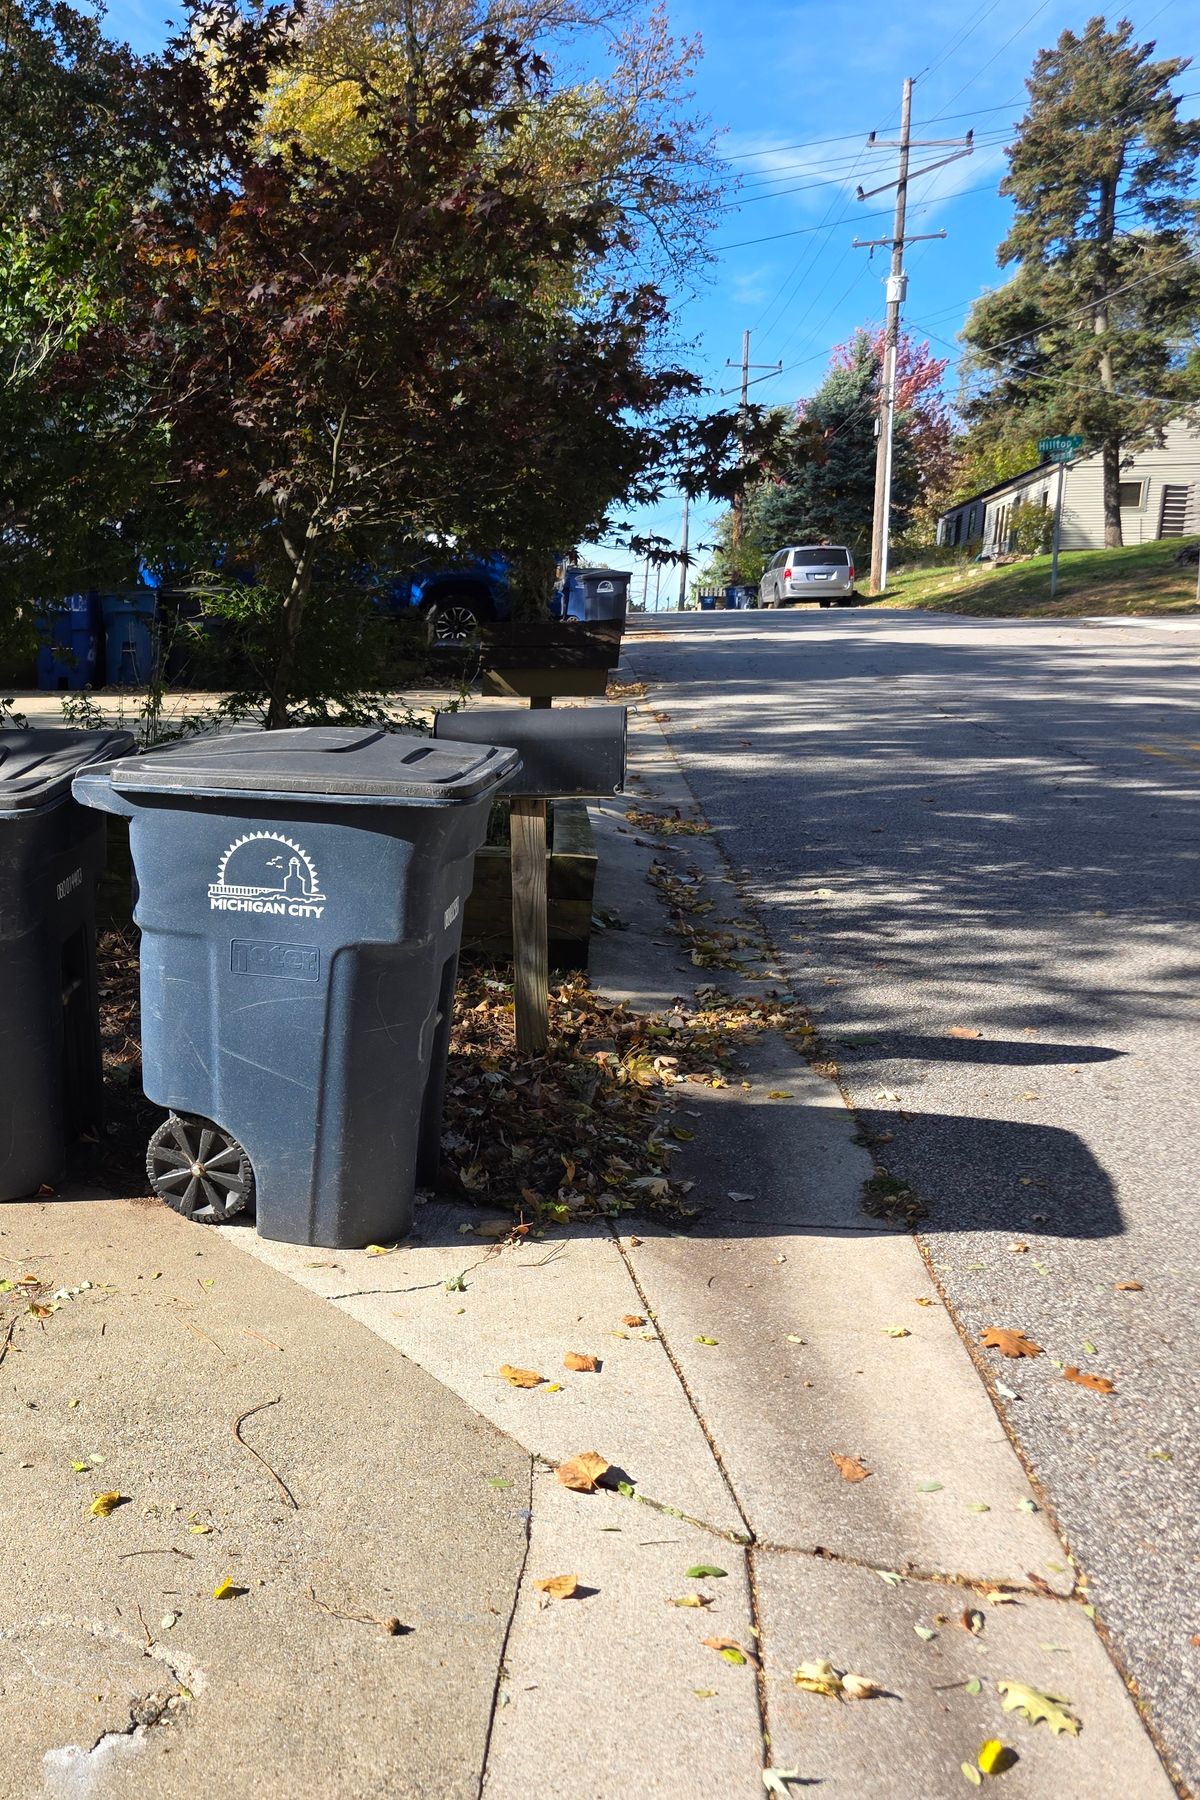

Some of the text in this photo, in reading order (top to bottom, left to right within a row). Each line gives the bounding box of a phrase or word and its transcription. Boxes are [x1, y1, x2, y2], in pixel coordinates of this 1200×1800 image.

[1039, 440, 1072, 451] Hilltop
[210, 898, 325, 919] MICHIGAN CITY
